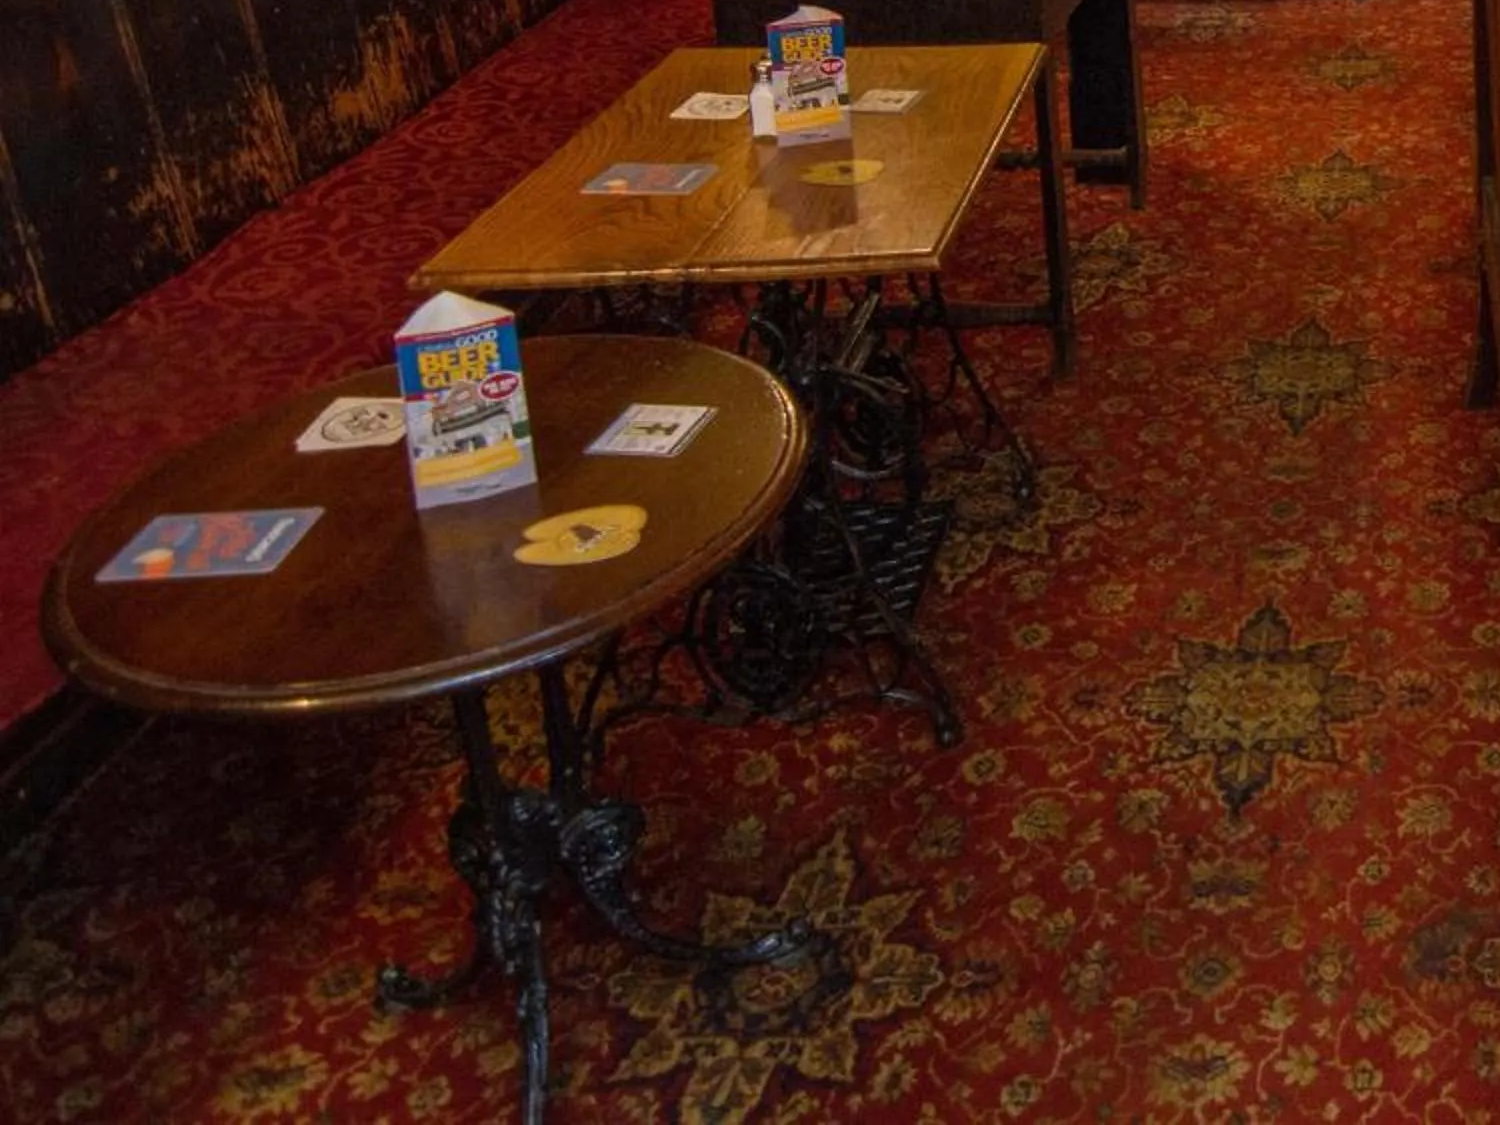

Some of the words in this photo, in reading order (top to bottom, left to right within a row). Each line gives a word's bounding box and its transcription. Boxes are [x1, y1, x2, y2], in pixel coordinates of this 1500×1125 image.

[781, 33, 833, 53] BEER
[455, 328, 499, 349] GOOD
[417, 340, 500, 375] BEER
